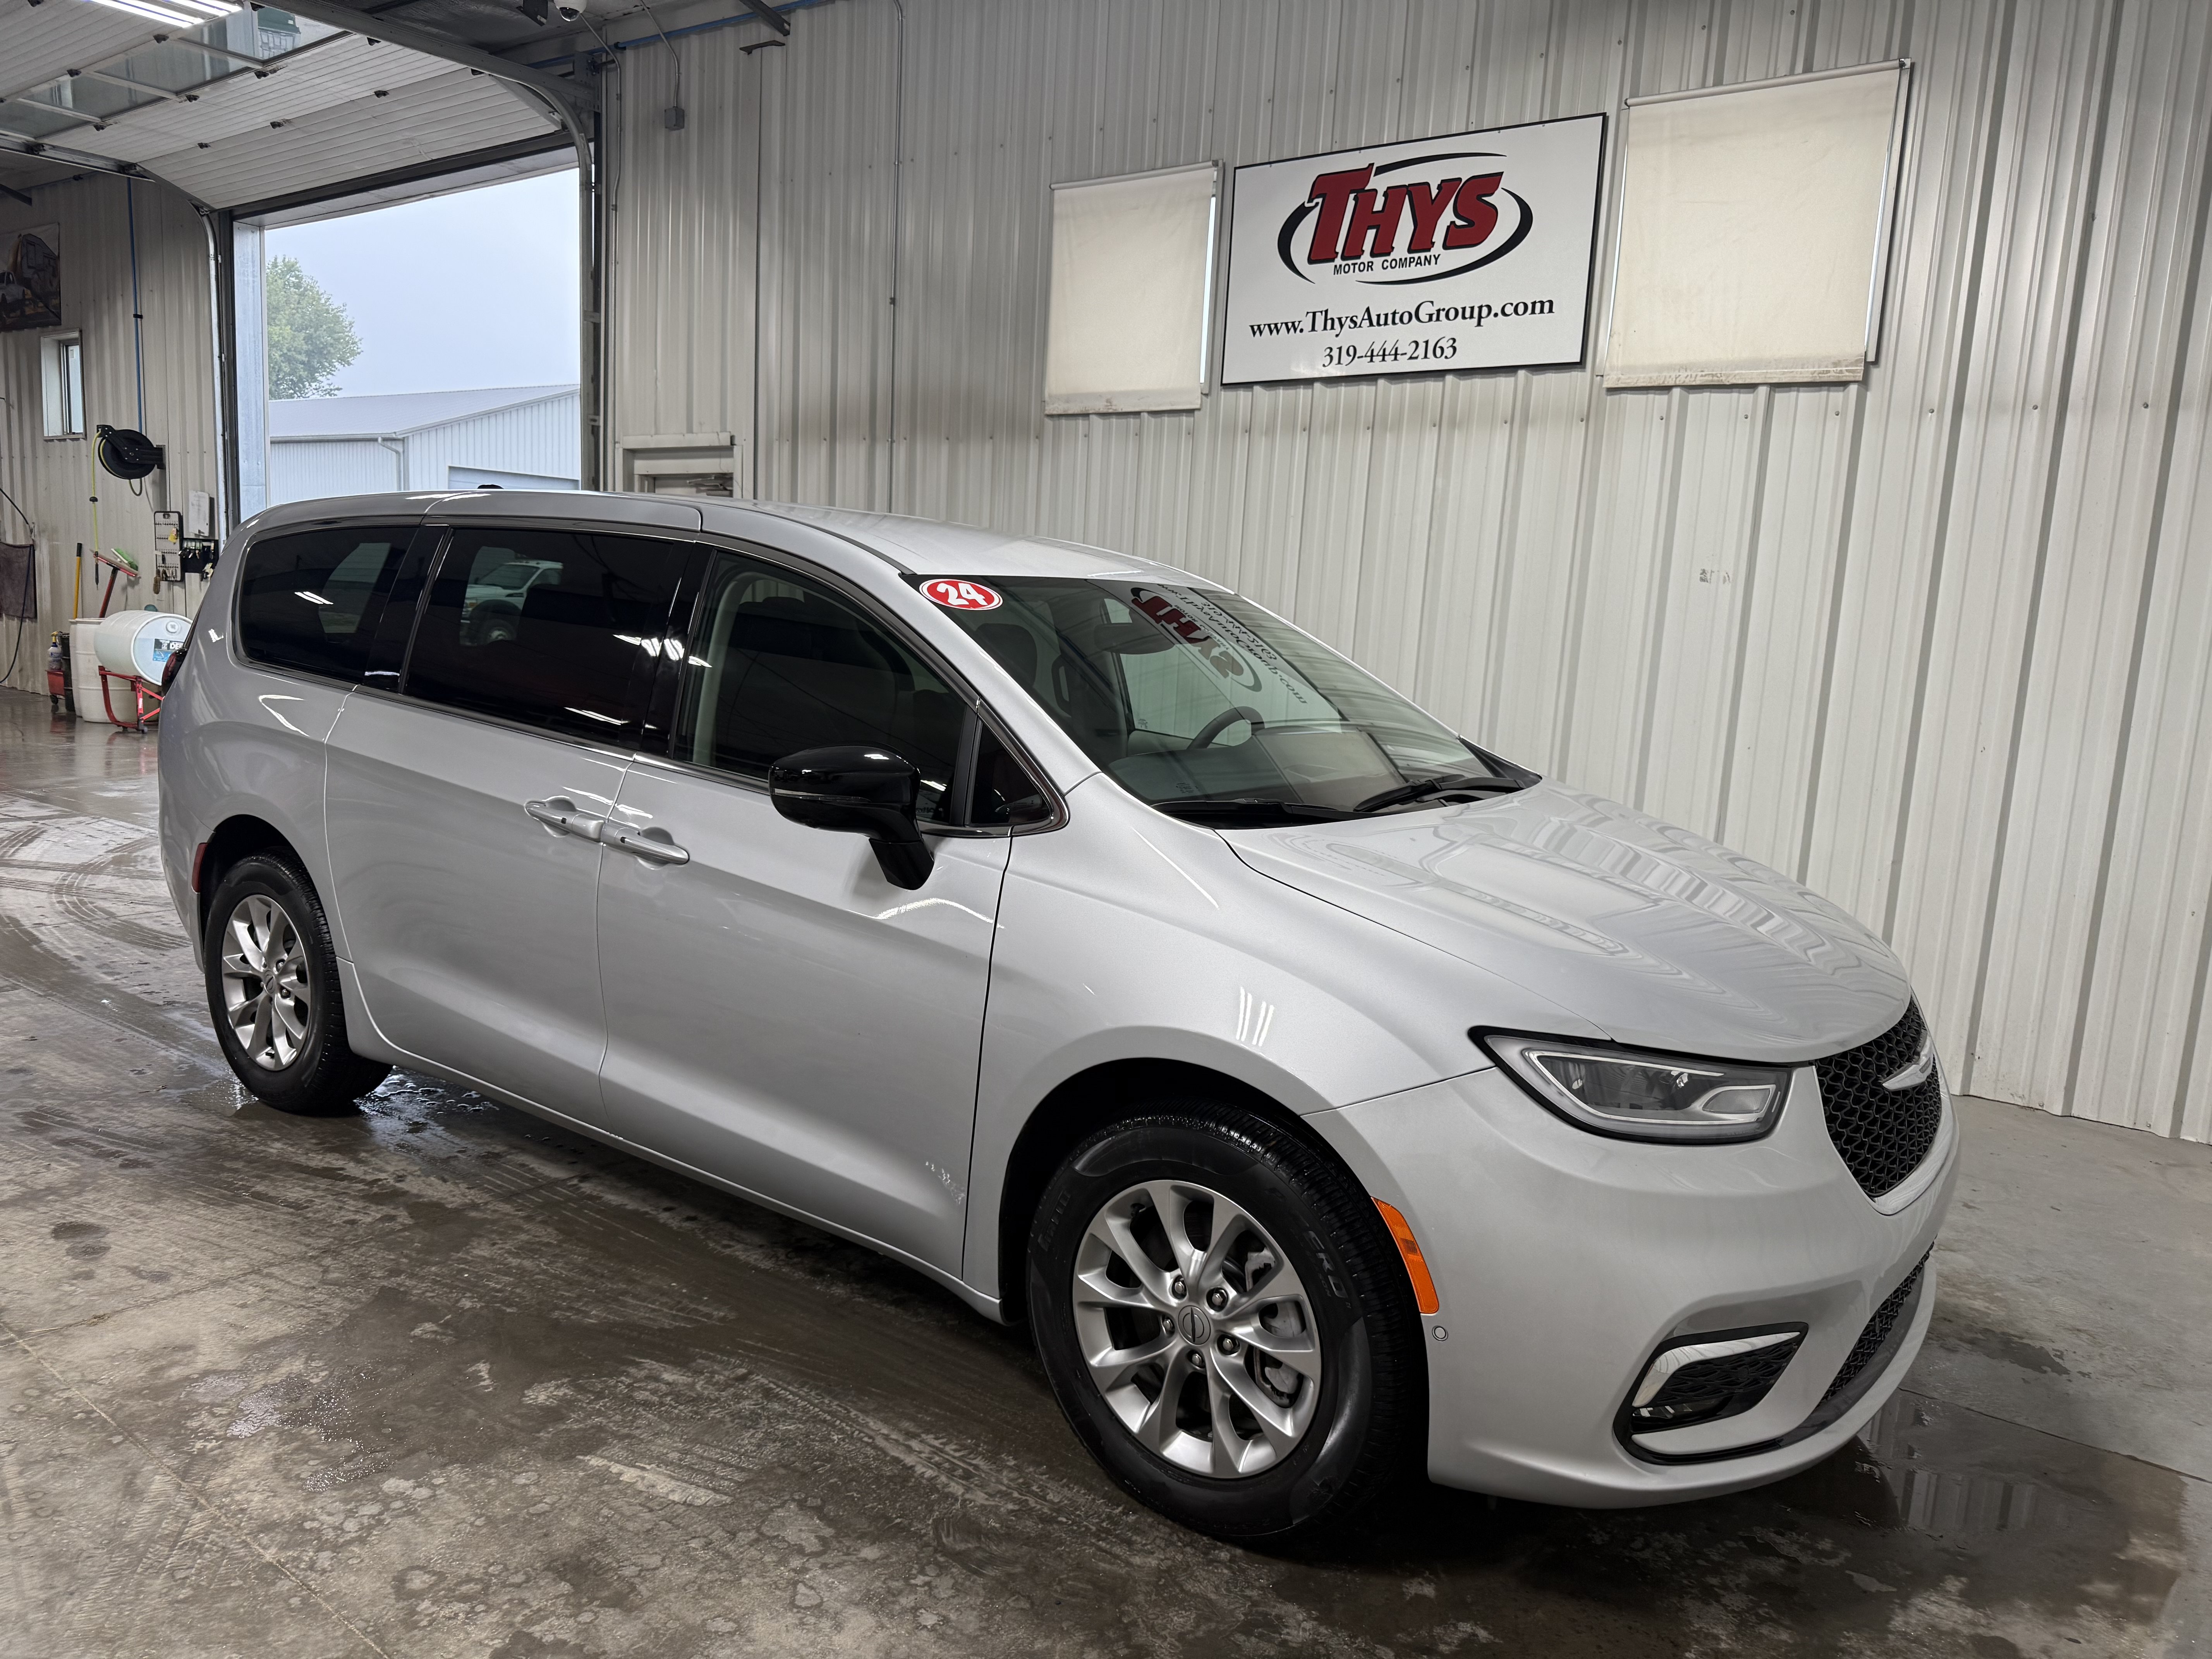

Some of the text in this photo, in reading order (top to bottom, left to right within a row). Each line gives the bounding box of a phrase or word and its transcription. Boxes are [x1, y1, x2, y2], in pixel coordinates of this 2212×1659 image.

[1307, 162, 1504, 265] THYS
[1333, 254, 1441, 275] MOTOR COMPANY
[1249, 299, 1555, 337] www.ThysAutoGroup.com
[1322, 336, 1457, 367] 319-444-2163
[936, 582, 988, 606] 24
